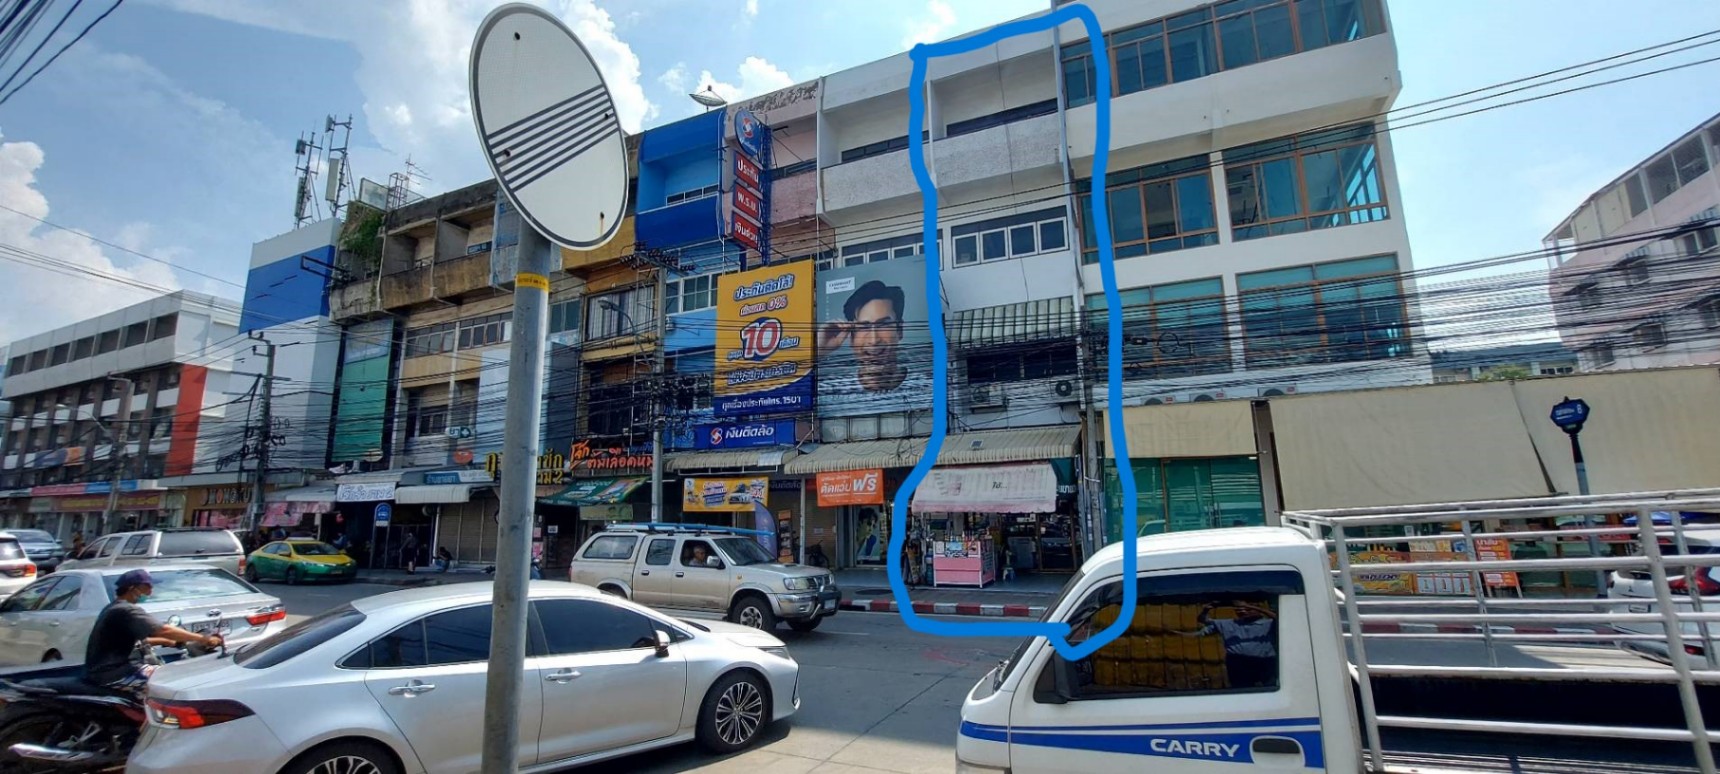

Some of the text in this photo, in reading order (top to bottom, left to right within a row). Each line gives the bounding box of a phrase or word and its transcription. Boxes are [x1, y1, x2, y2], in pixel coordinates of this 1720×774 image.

[767, 295, 788, 312] 0%
[741, 319, 782, 359] 10
[725, 423, 775, 439] เงินติดล้อ
[852, 472, 878, 492] ฟรี
[1150, 738, 1240, 758] CARRY
